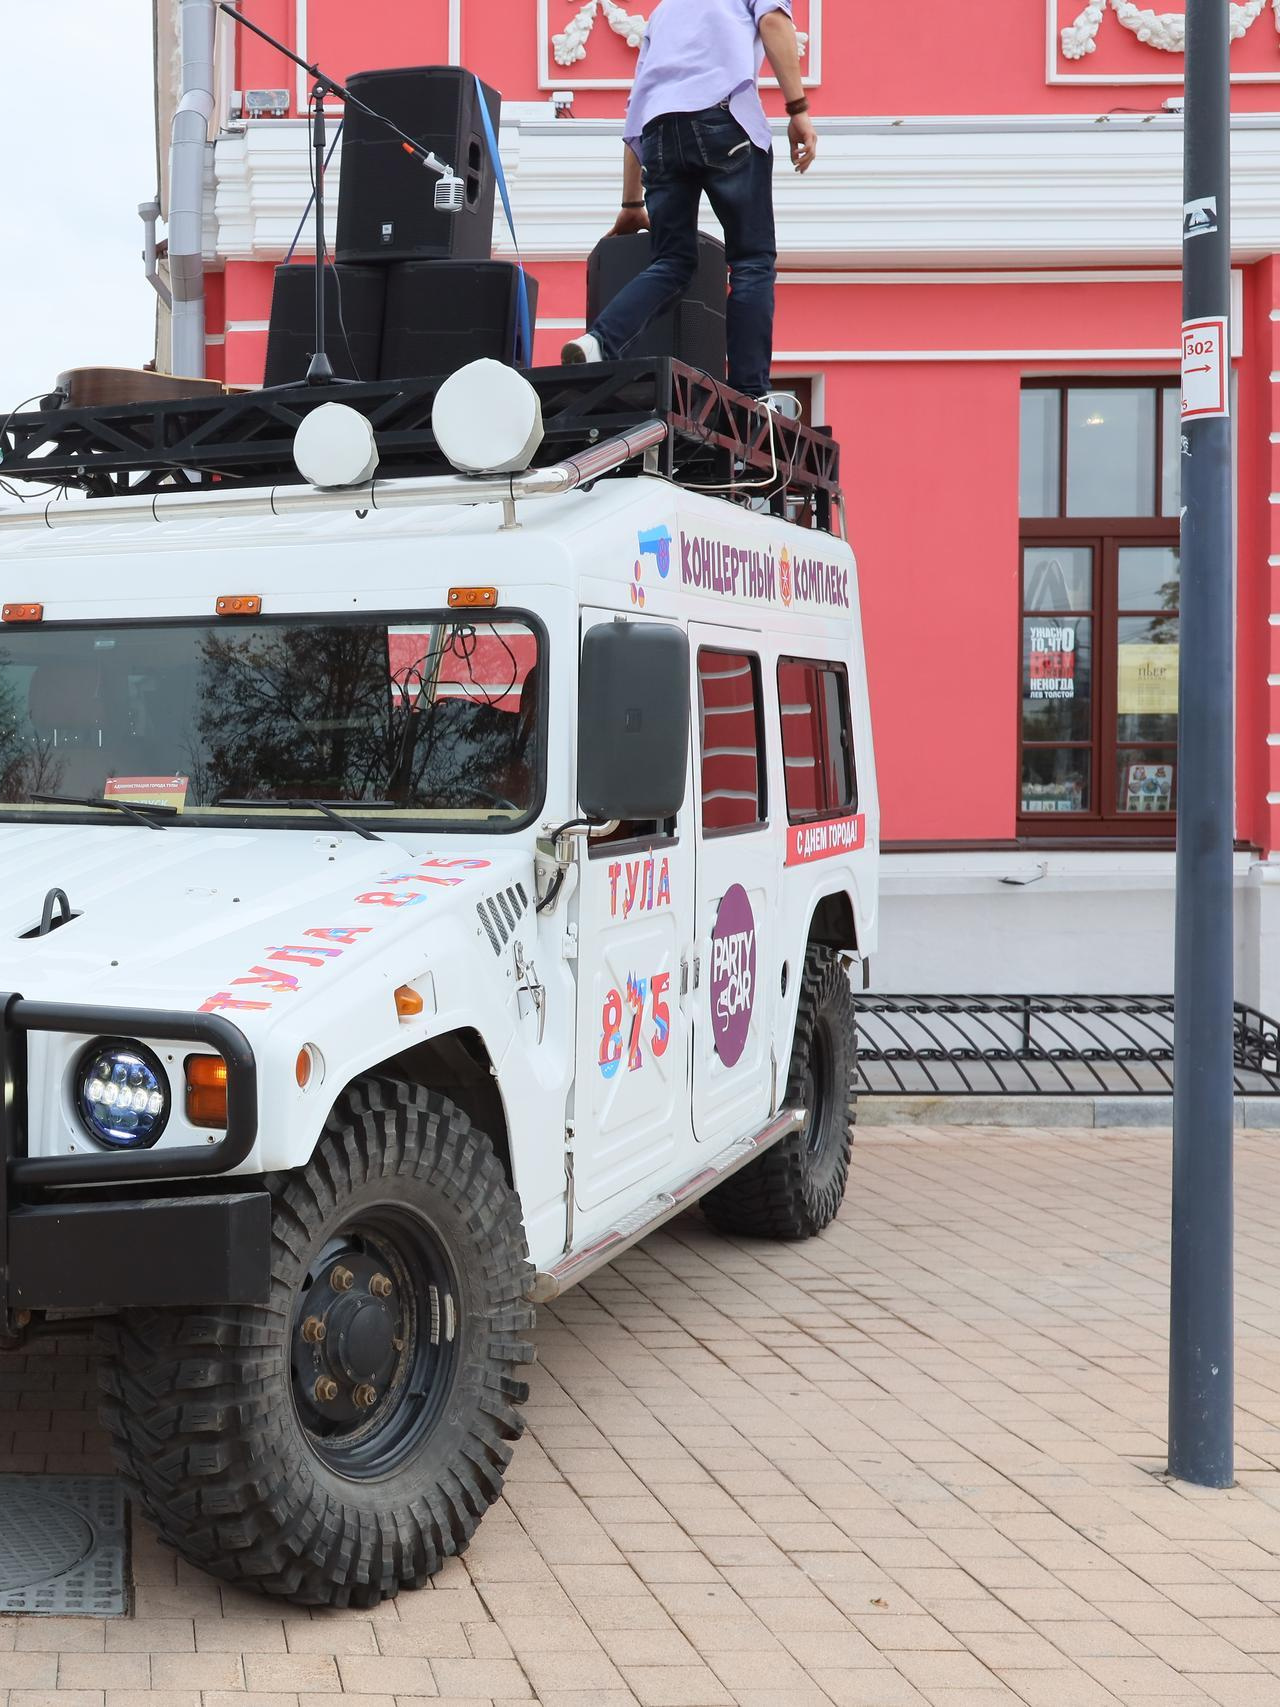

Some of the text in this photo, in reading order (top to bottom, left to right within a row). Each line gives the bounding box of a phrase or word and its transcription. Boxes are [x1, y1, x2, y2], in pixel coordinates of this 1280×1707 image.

[680, 531, 850, 609] КОНЦЕРТНЫЙ КОМПЛЕКС
[1045, 691, 1074, 699] ТОЛСТОЙ
[797, 819, 858, 858] С ДНЕМ ГОРОДА!
[608, 845, 671, 919] ТУЛА
[196, 858, 492, 1013] ТУЛА 875
[714, 929, 754, 983] PARTY
[597, 970, 670, 1079] 875
[728, 970, 752, 1016] CAR
